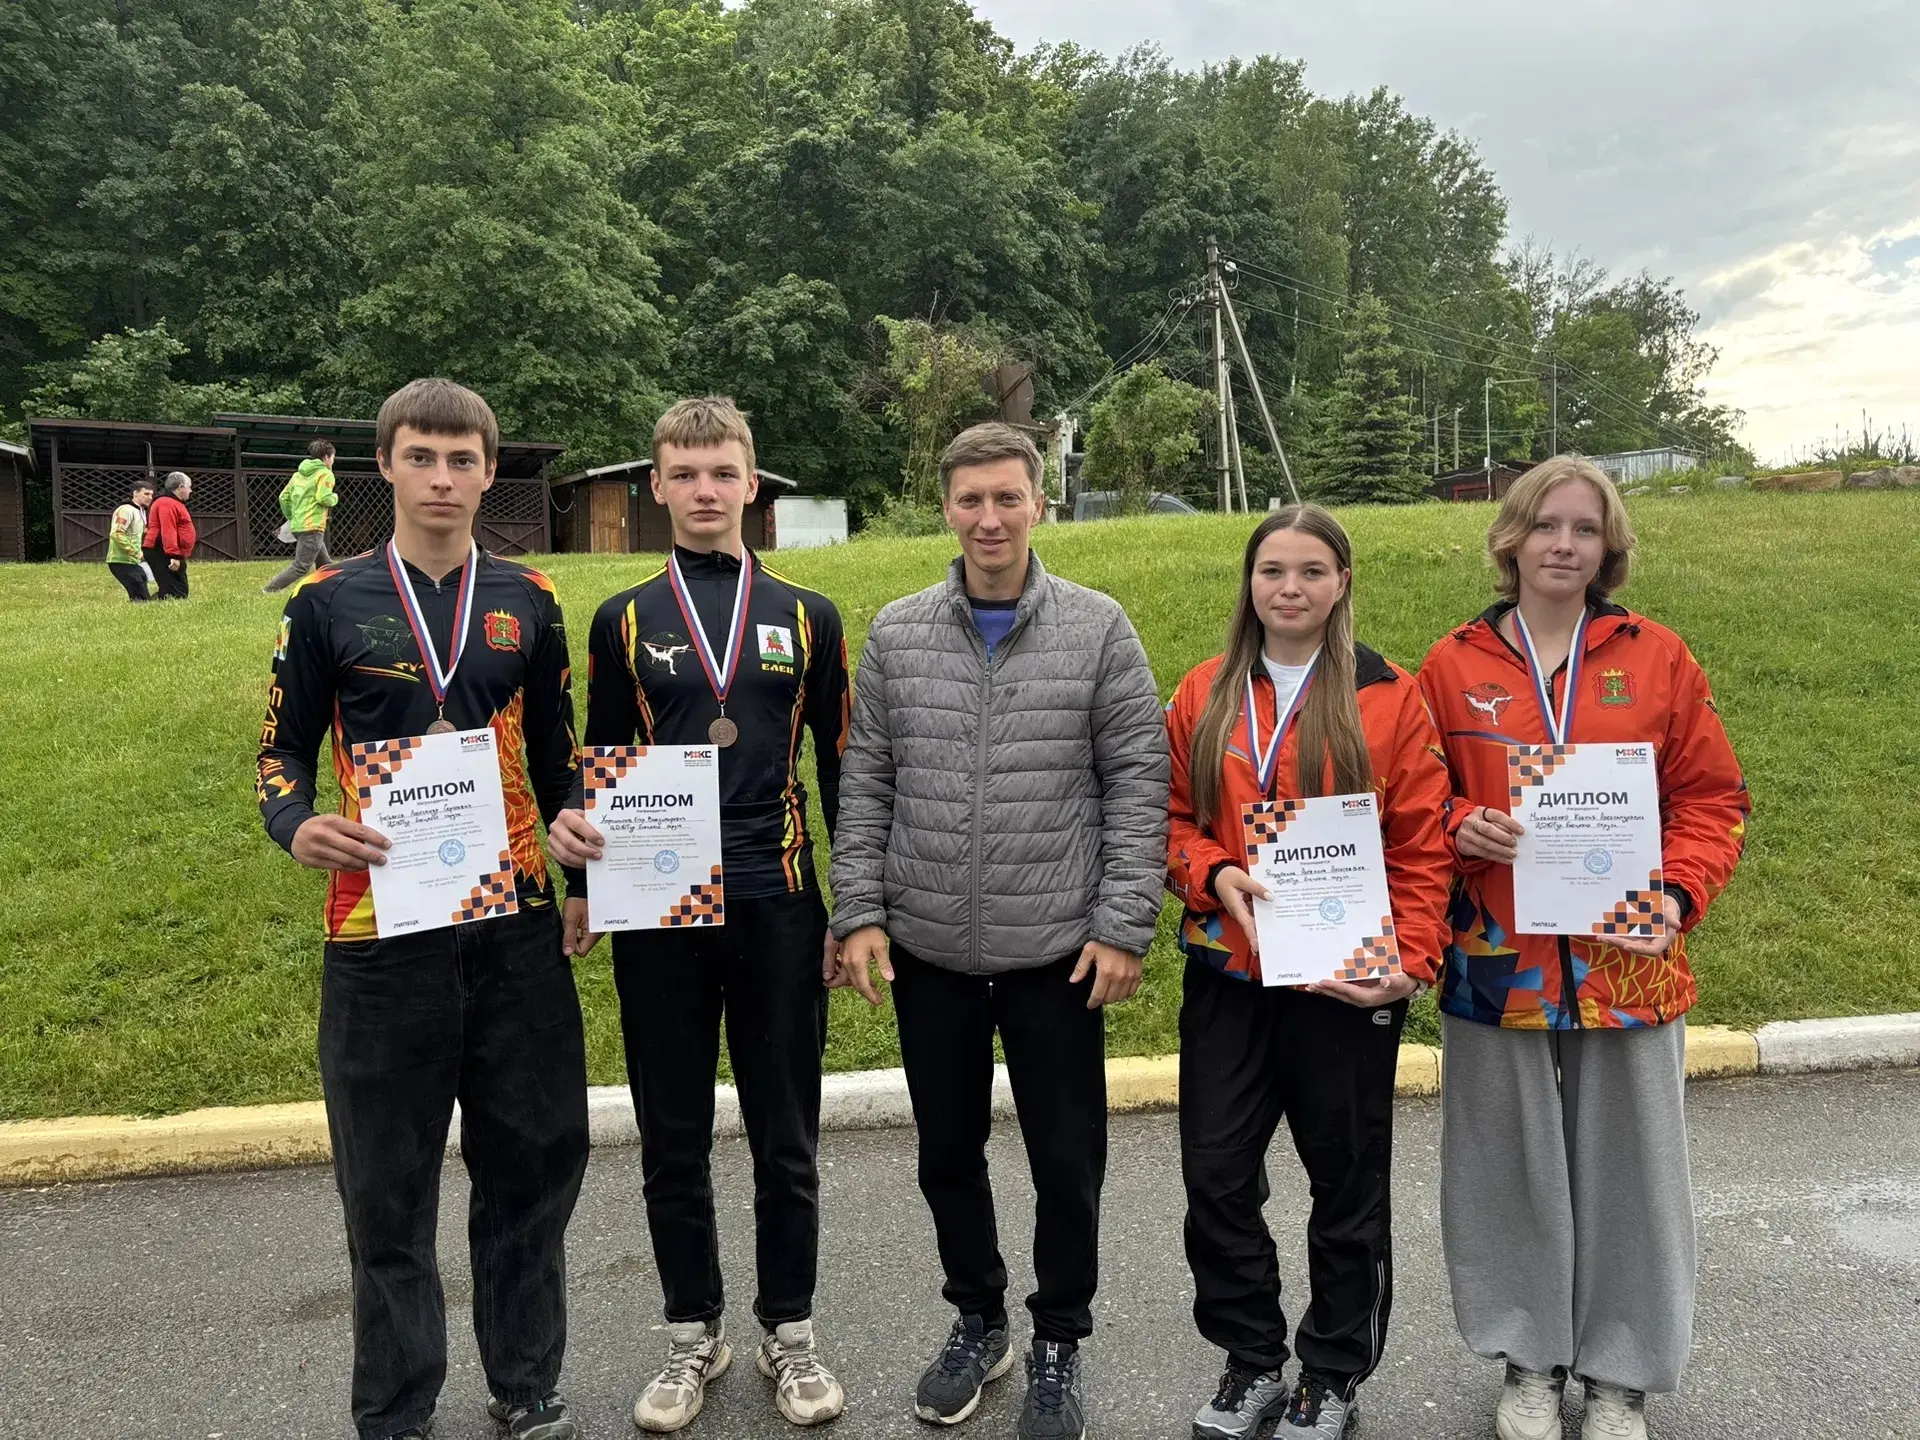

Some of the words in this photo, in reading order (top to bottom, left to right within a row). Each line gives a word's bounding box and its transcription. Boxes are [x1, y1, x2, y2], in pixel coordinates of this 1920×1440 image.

[631, 485, 638, 495] 2
[761, 663, 794, 676] ЕЛЕЦ
[388, 780, 475, 807] ДИПЛОМ
[1538, 791, 1628, 808] ДИПЛОМ
[610, 794, 693, 810] ДИПЛОМ
[1273, 843, 1357, 865] ДИПЛОМ
[393, 918, 419, 929] ЛИПЕЦК
[603, 918, 629, 926] ЛИПЕЦК
[1276, 972, 1302, 980] ЛИПЕЦК
